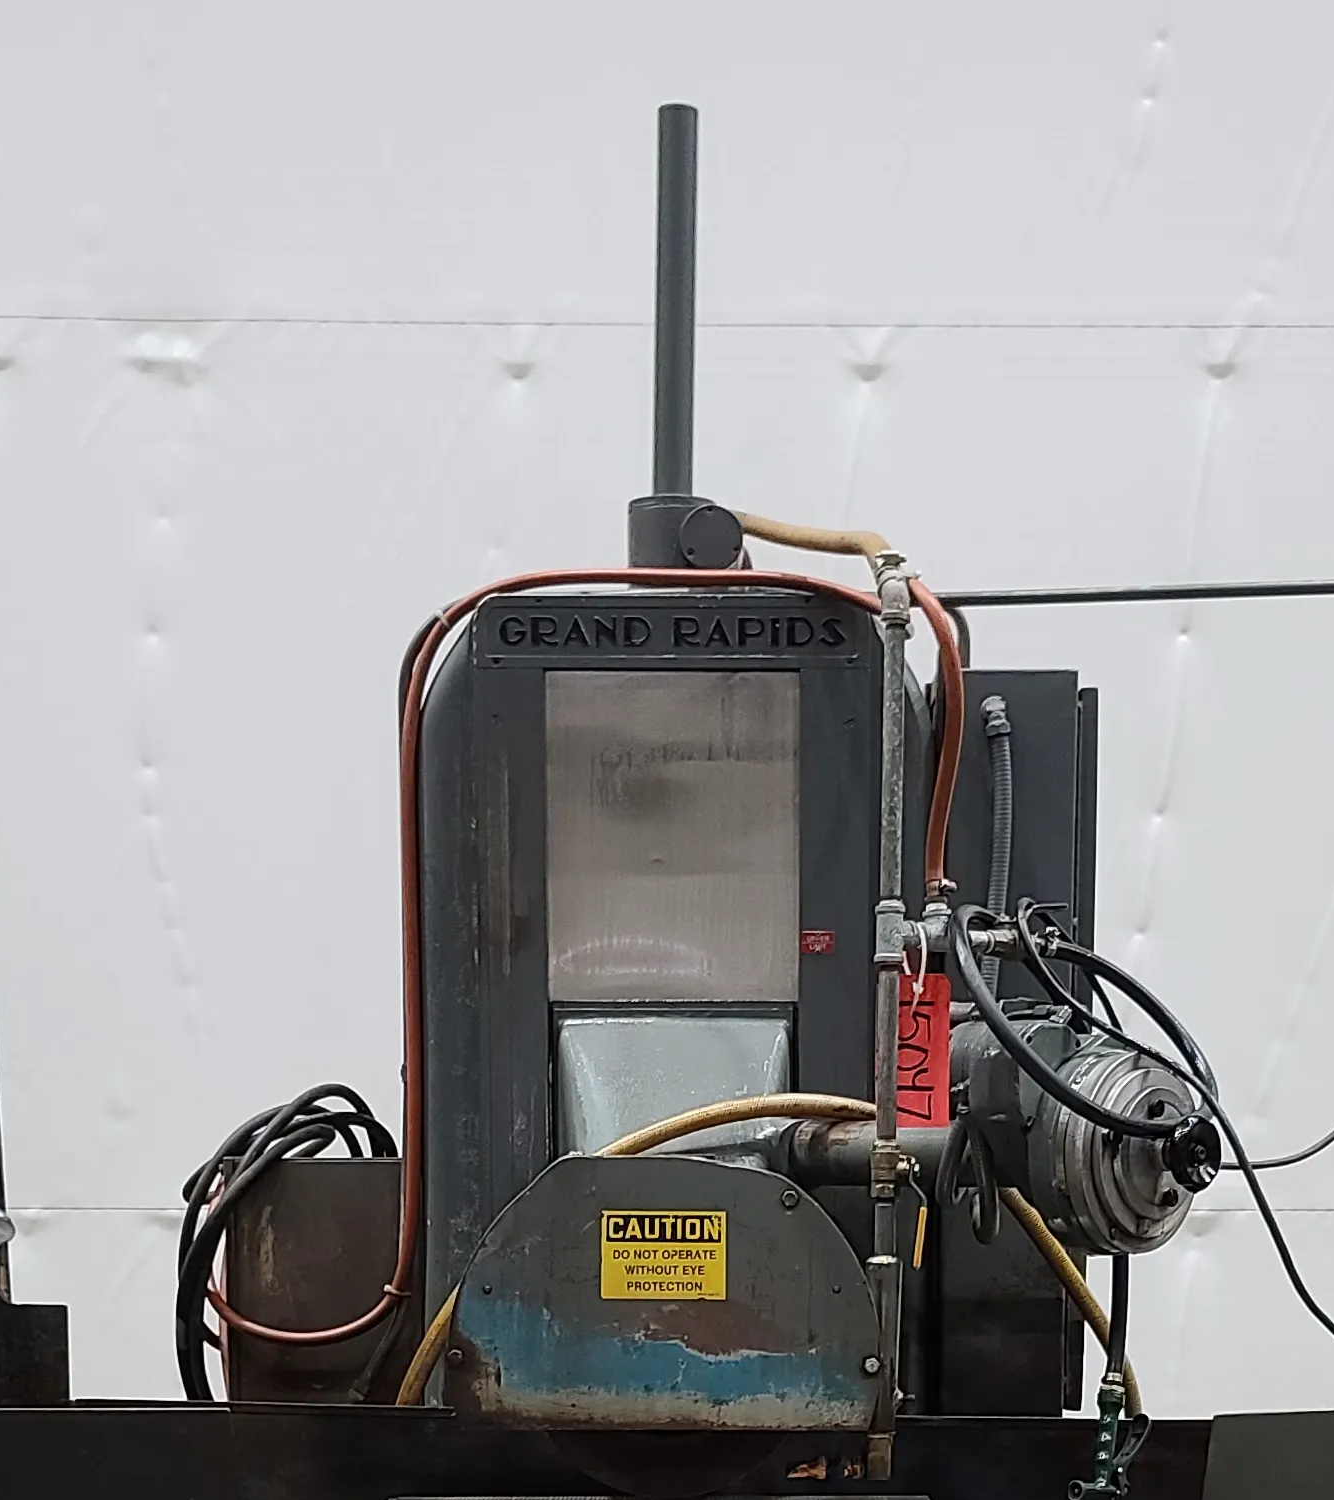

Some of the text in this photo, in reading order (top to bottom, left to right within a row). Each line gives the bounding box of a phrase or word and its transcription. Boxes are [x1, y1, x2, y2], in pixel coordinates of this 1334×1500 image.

[498, 614, 848, 649] GRAND RAPIDS
[608, 1217, 720, 1240] CAUTION
[613, 1249, 717, 1260] DO NOT OPERATE
[624, 1265, 706, 1276] WITHOUT EYE
[627, 1281, 703, 1292] PROTECTION
